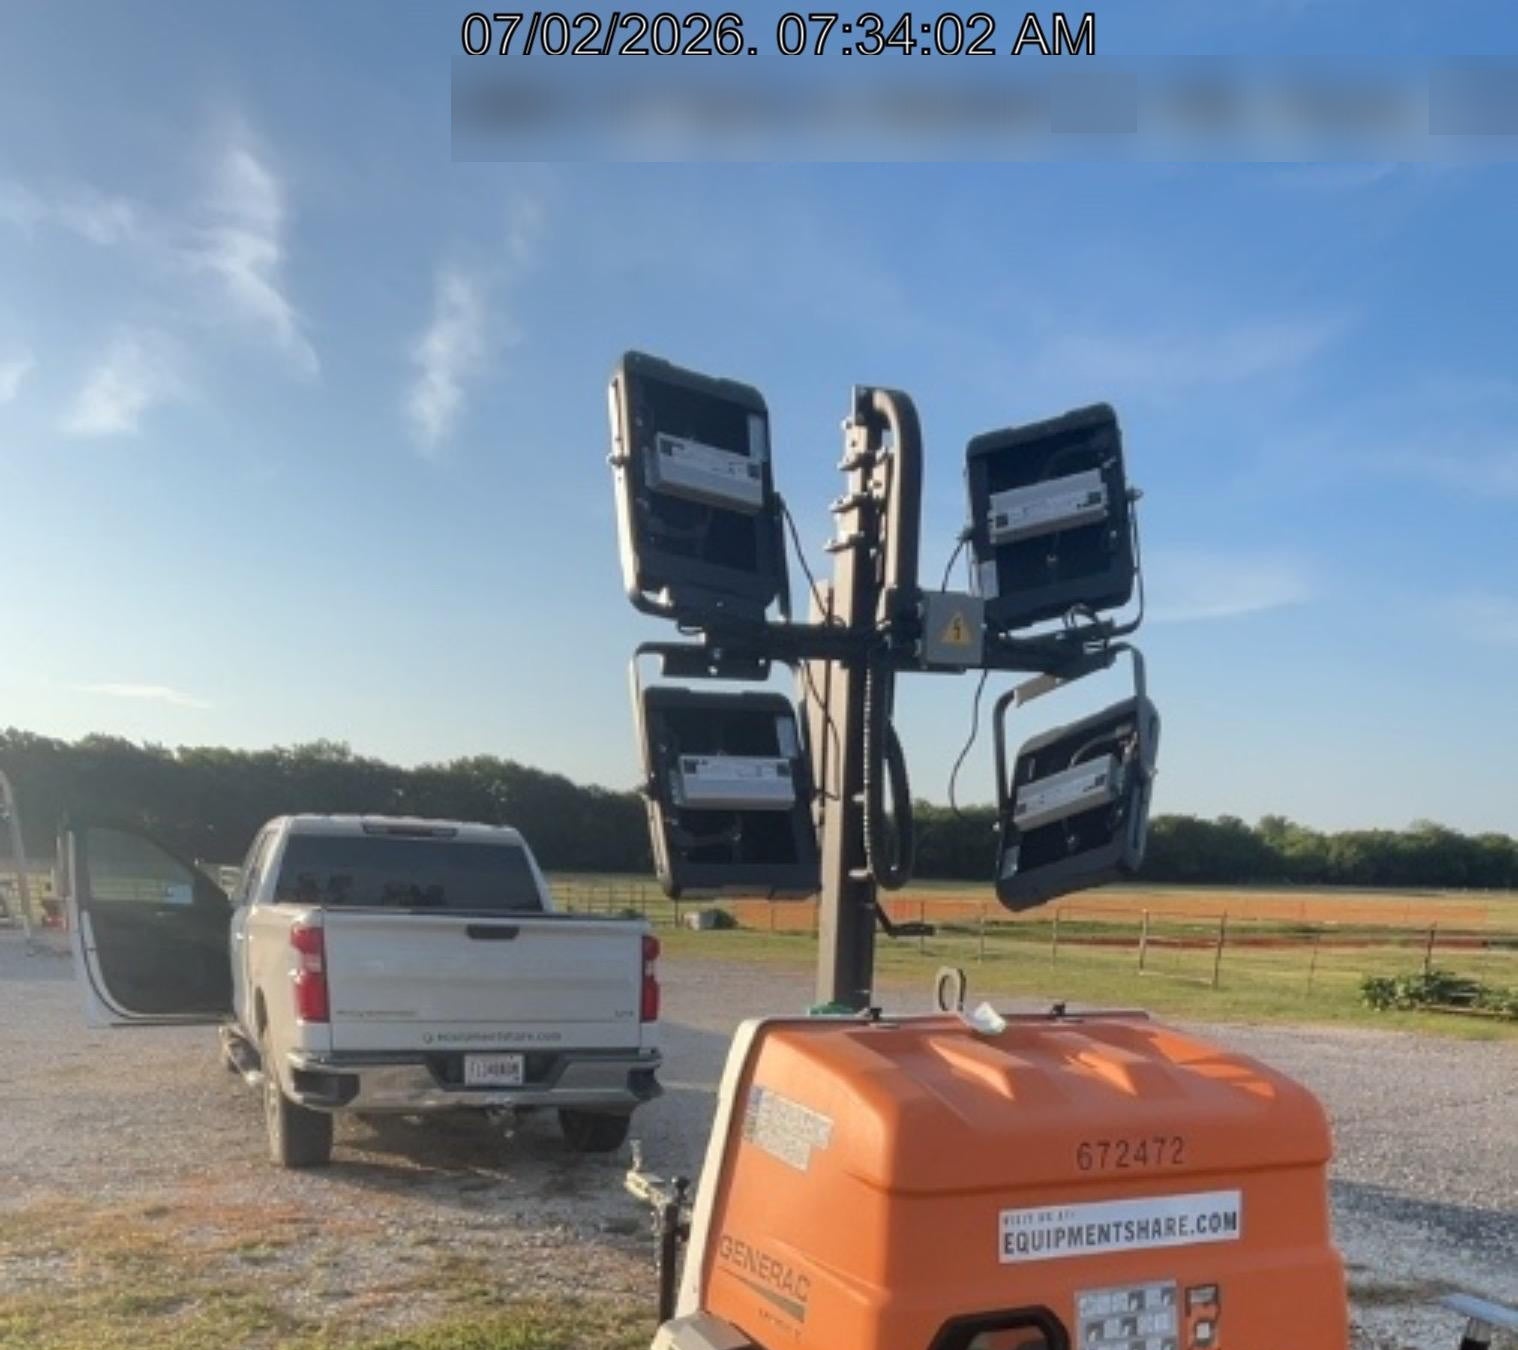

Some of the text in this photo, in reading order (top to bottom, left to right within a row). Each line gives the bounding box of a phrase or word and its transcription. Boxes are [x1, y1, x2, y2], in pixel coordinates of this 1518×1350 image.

[1075, 1135, 1185, 1171] 672472
[1003, 1210, 1238, 1255] EQUIPMENTSHARE.COM
[719, 1234, 811, 1303] GENERAC
